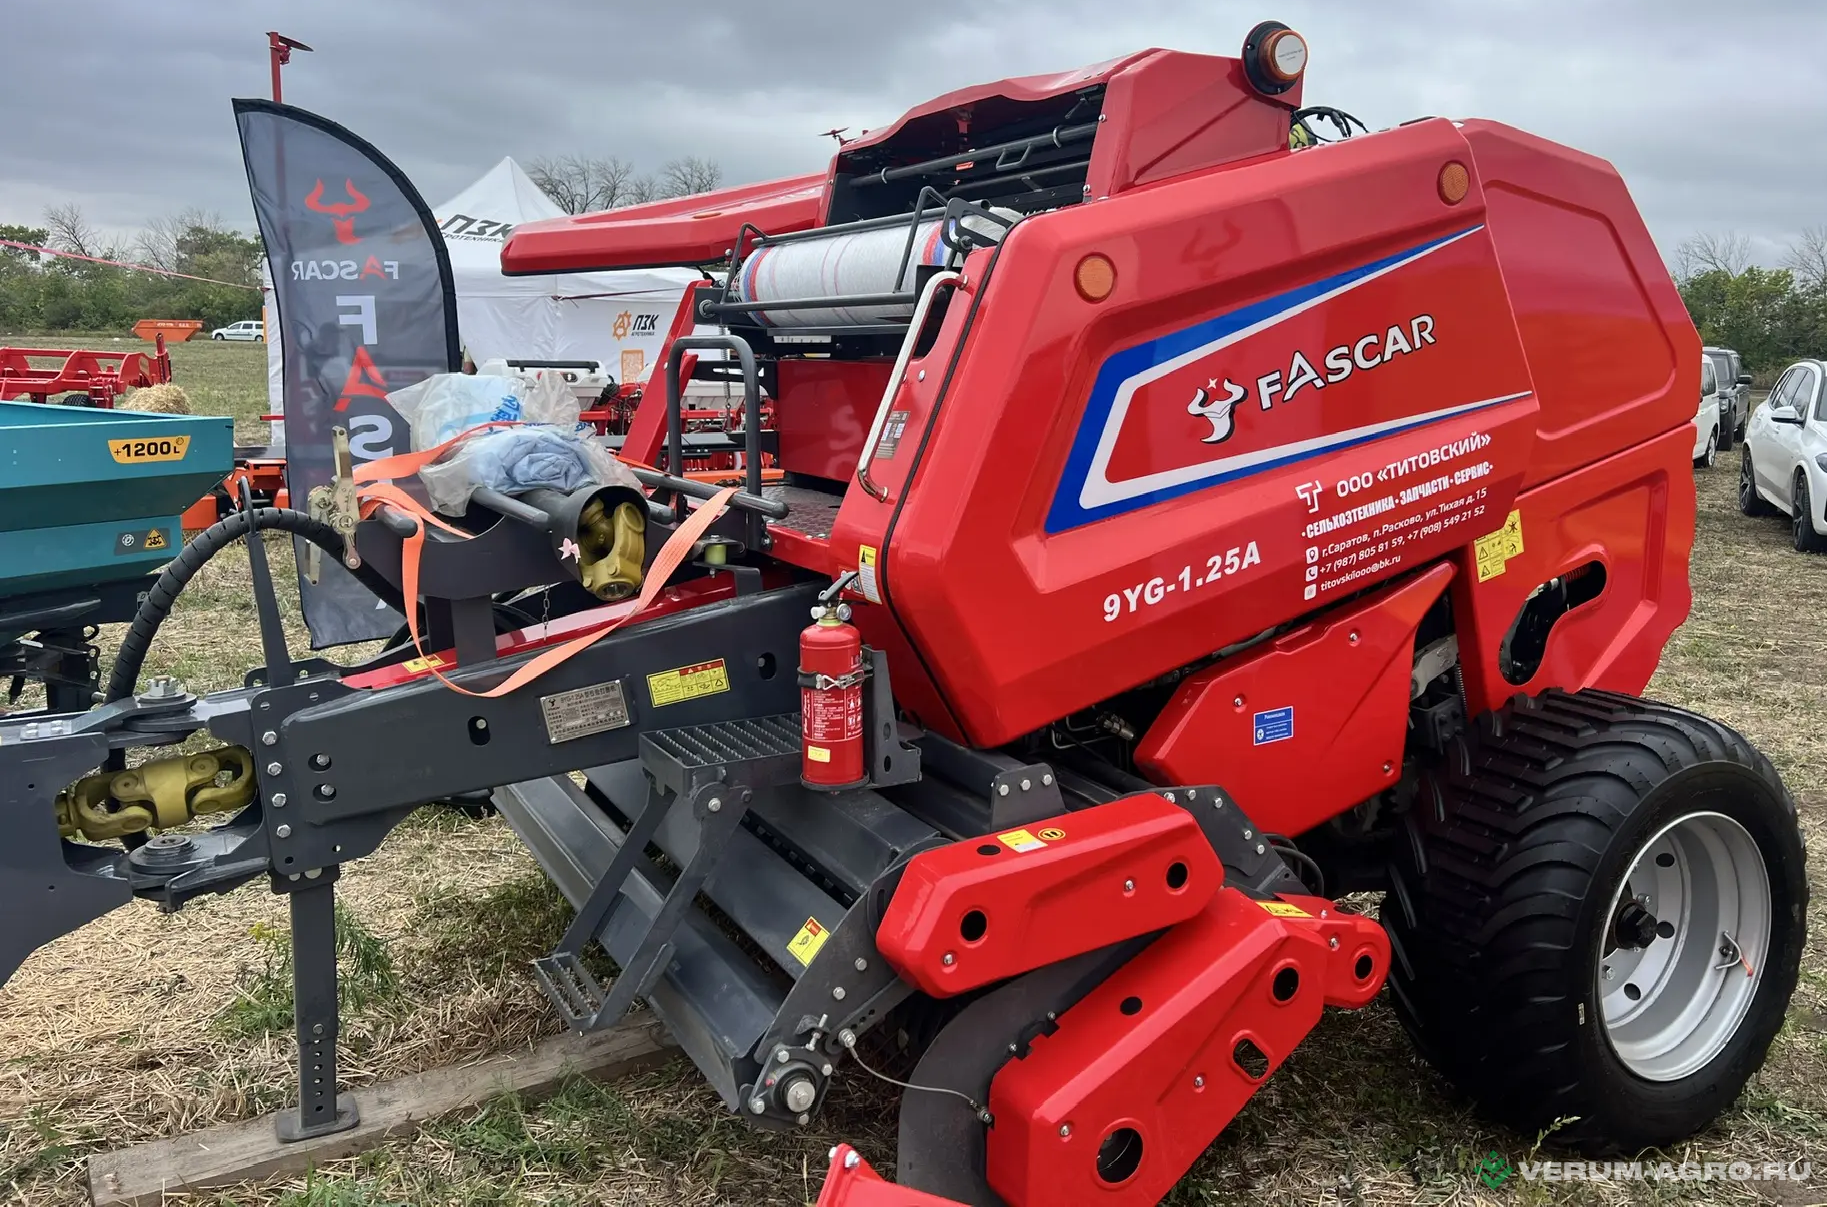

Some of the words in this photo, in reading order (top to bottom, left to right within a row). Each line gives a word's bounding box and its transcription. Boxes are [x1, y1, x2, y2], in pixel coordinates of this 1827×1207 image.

[632, 314, 659, 331] ПЗК
[1256, 313, 1437, 411] FASCAR
[1336, 471, 1373, 497] ООО
[1377, 431, 1491, 482] «ТИТОВСКИЙ»
[1320, 562, 1332, 573] +7
[1333, 553, 1357, 572] (987)
[1358, 546, 1376, 560] 805
[1378, 541, 1389, 553] 81
[1391, 535, 1405, 548] 59,
[1407, 530, 1419, 540] +7
[1420, 521, 1442, 539] (908)
[1443, 514, 1460, 528] 549
[1461, 510, 1472, 521] 21
[1474, 505, 1485, 517] 52
[1103, 541, 1261, 622] 9YG-1.25A
